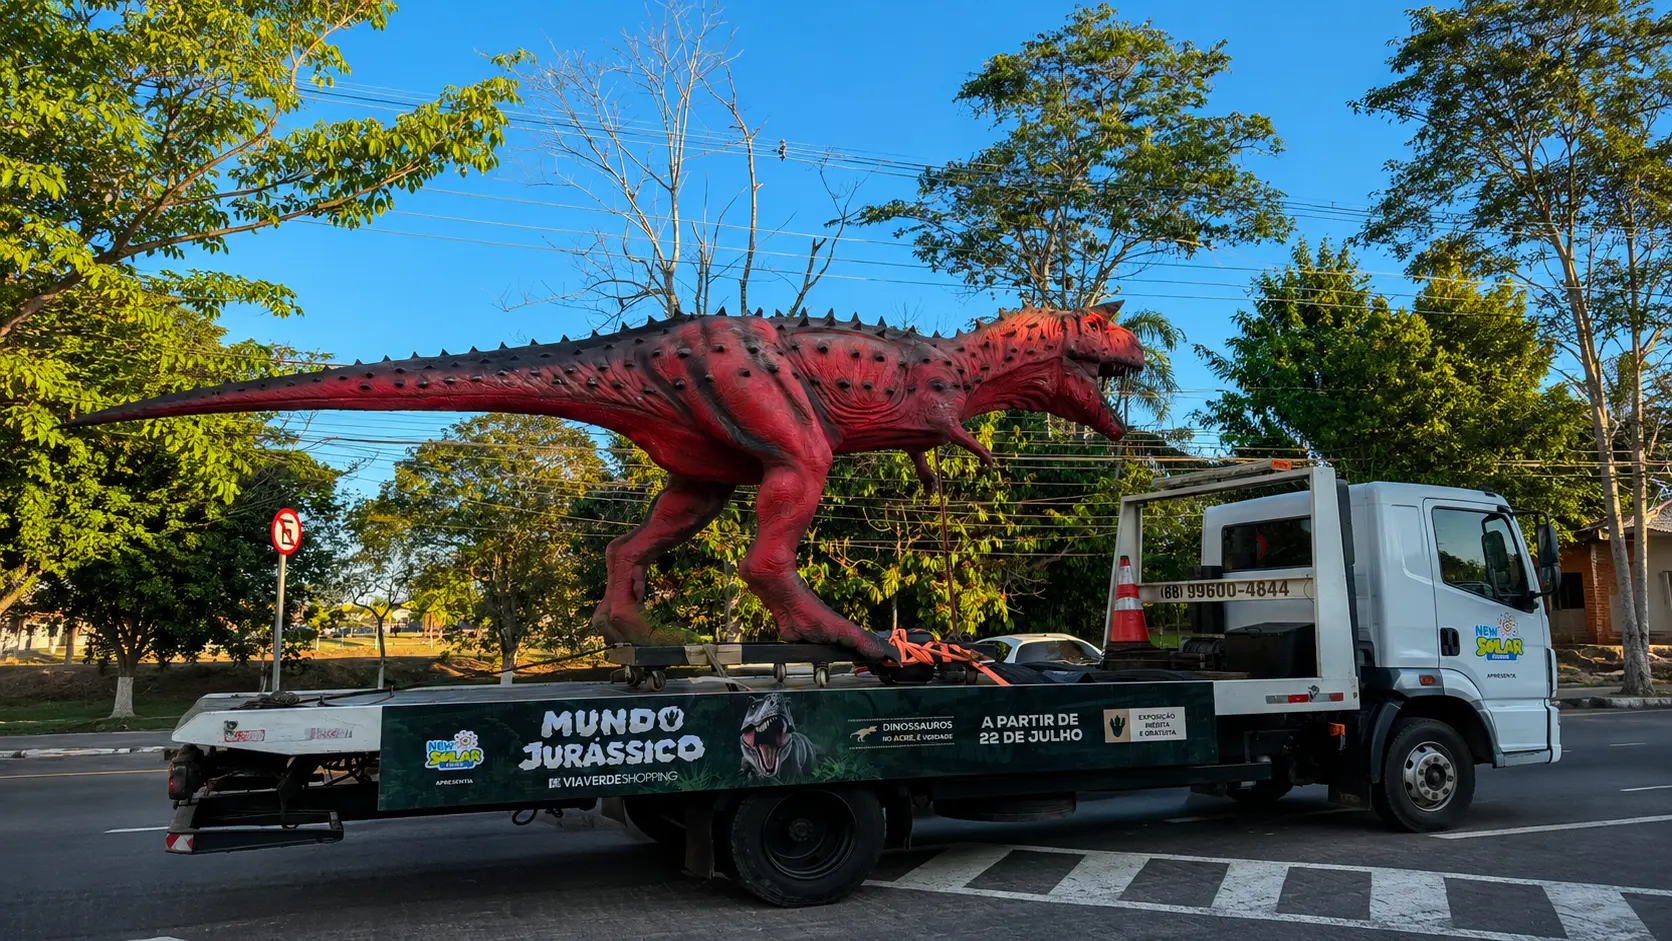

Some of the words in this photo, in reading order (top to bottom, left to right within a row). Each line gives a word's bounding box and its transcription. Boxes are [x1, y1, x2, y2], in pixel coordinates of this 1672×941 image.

[1160, 584, 1183, 599] (88)
[1187, 580, 1290, 599] 99600-4844
[1476, 636, 1524, 657] SOLAR
[540, 705, 685, 738] MUNDO
[882, 721, 953, 731] DINOSSAUROS
[981, 716, 994, 729] A
[997, 714, 1055, 729] PARTIR
[1058, 713, 1079, 726] DE
[979, 731, 999, 744] 22
[1003, 730, 1025, 744] DE
[1028, 728, 1083, 743] JULHO
[429, 750, 481, 766] SOLAR
[518, 734, 706, 771] JURÁSSICO
